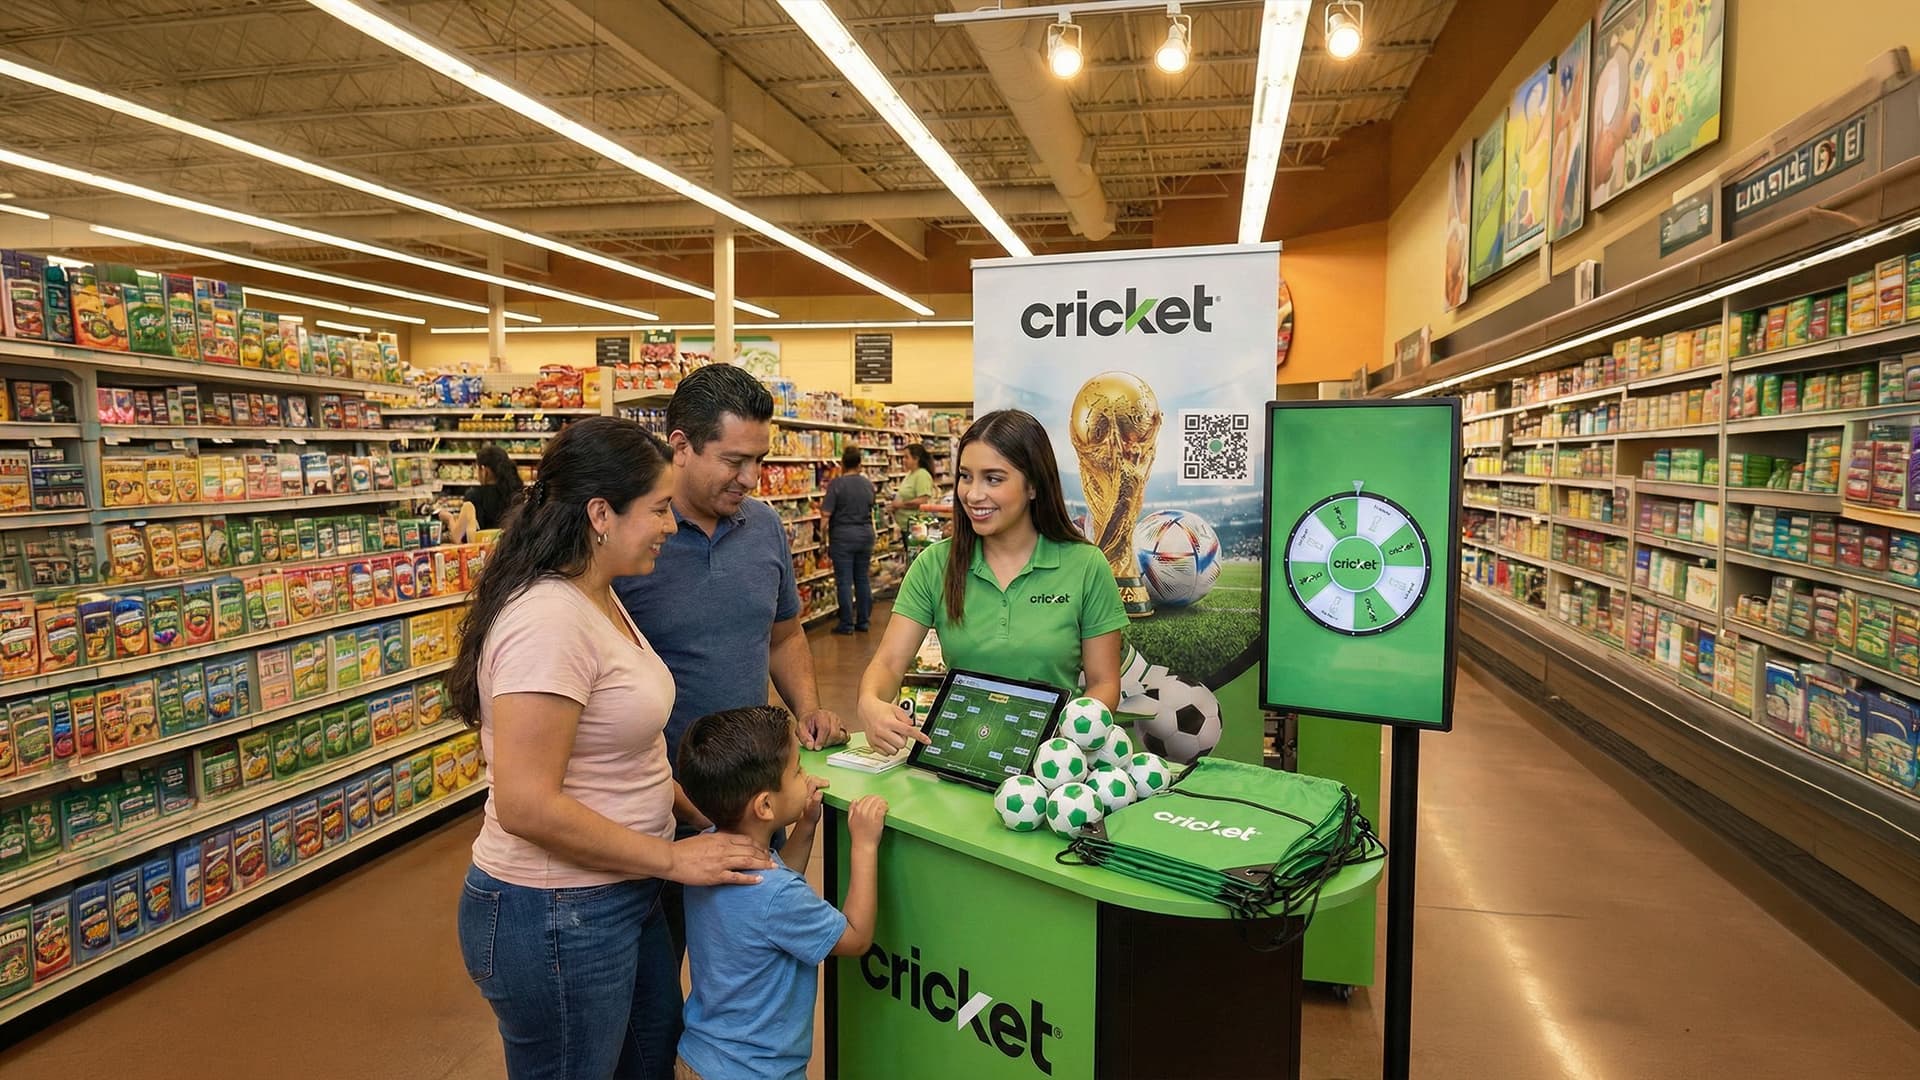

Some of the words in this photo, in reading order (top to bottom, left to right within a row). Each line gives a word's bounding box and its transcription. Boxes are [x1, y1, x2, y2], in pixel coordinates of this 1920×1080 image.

[1333, 558, 1378, 570] cricket
[1030, 592, 1071, 604] cricket
[1152, 811, 1258, 842] cricket
